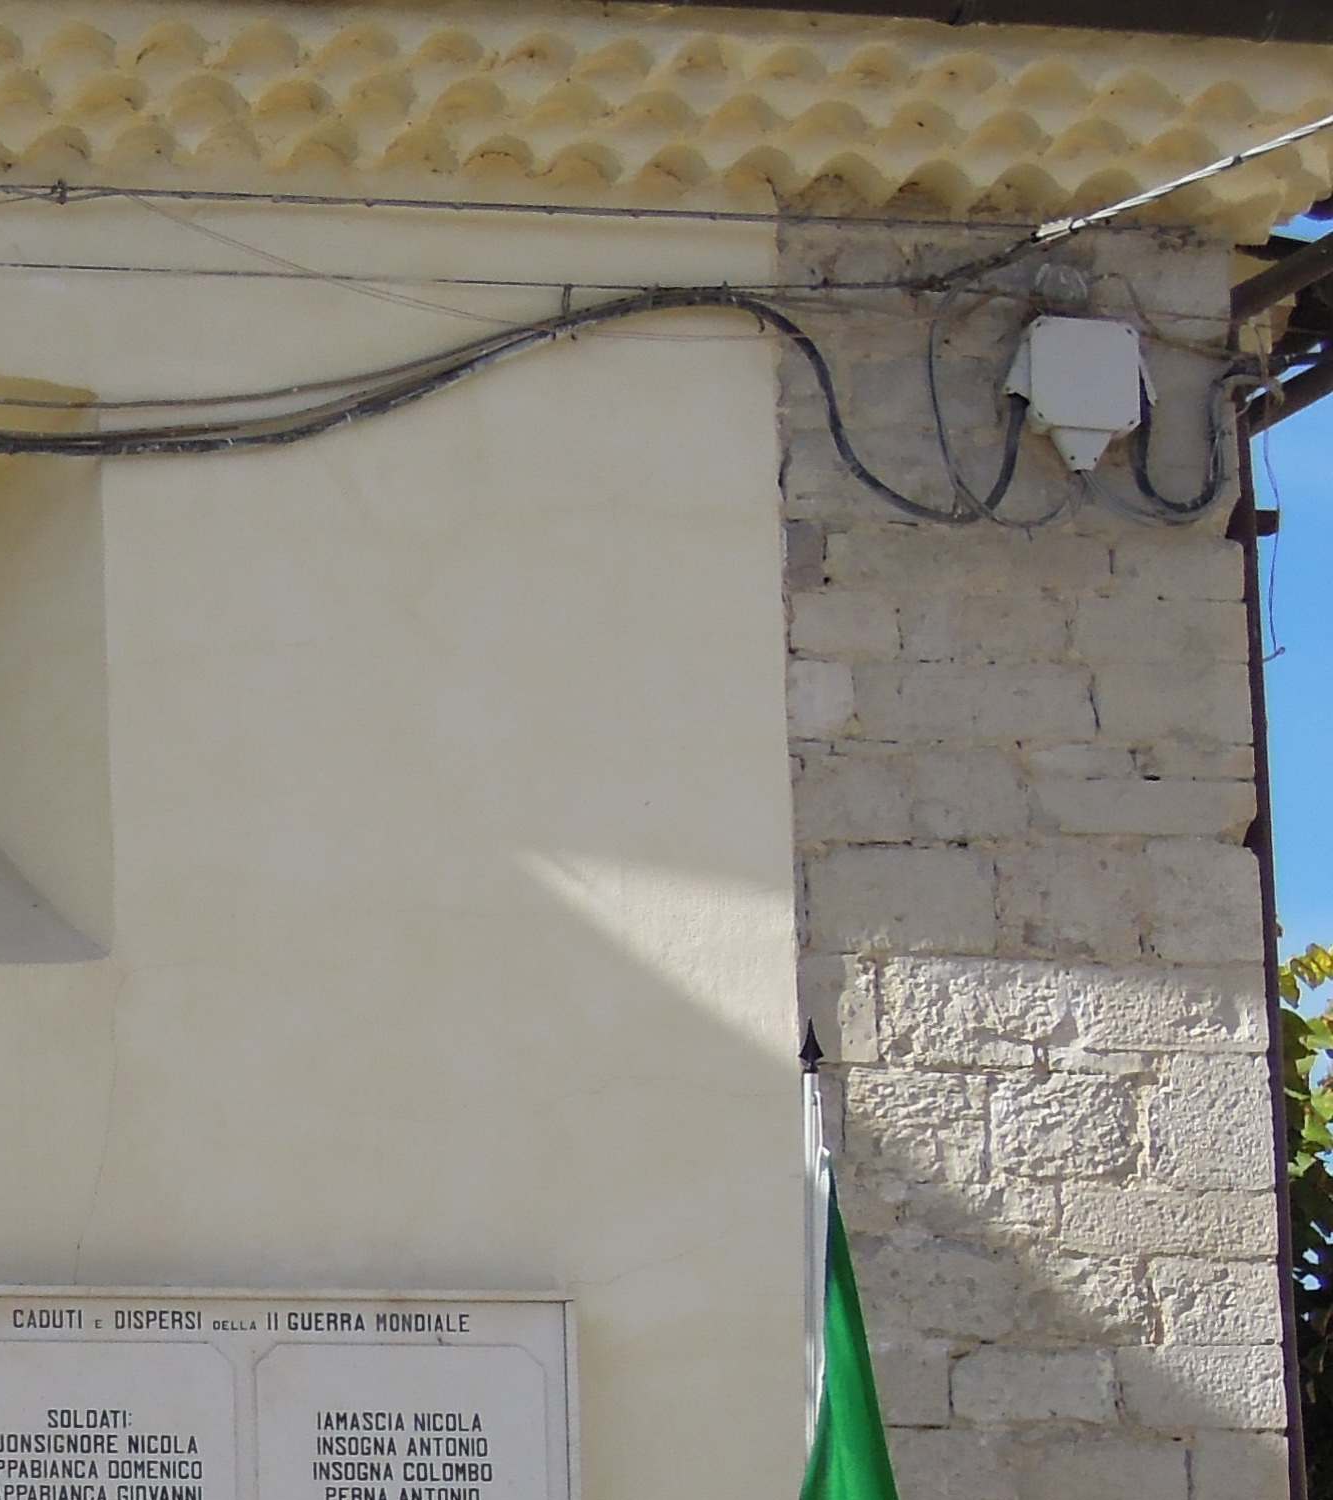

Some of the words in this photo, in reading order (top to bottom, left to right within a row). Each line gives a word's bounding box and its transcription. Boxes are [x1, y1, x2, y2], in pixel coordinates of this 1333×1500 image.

[12, 1308, 83, 1330] CADUTI
[94, 1319, 103, 1329] E
[114, 1309, 202, 1330] DISPERSI
[212, 1320, 257, 1331] DELLA
[267, 1311, 279, 1331] II
[287, 1311, 366, 1332] GUERRA
[376, 1313, 470, 1333] MONDIALE
[47, 1409, 132, 1429] SOLDATI:
[317, 1411, 405, 1432] IAMASCIA
[413, 1412, 482, 1433] NICOLA
[127, 1434, 199, 1455] NICOLA
[316, 1436, 397, 1457] INSOGNA
[406, 1436, 488, 1458] ANTONIO
[107, 1459, 203, 1480] DOMENICO
[313, 1461, 394, 1482] INSOGNA
[403, 1462, 493, 1482] COLOMBO
